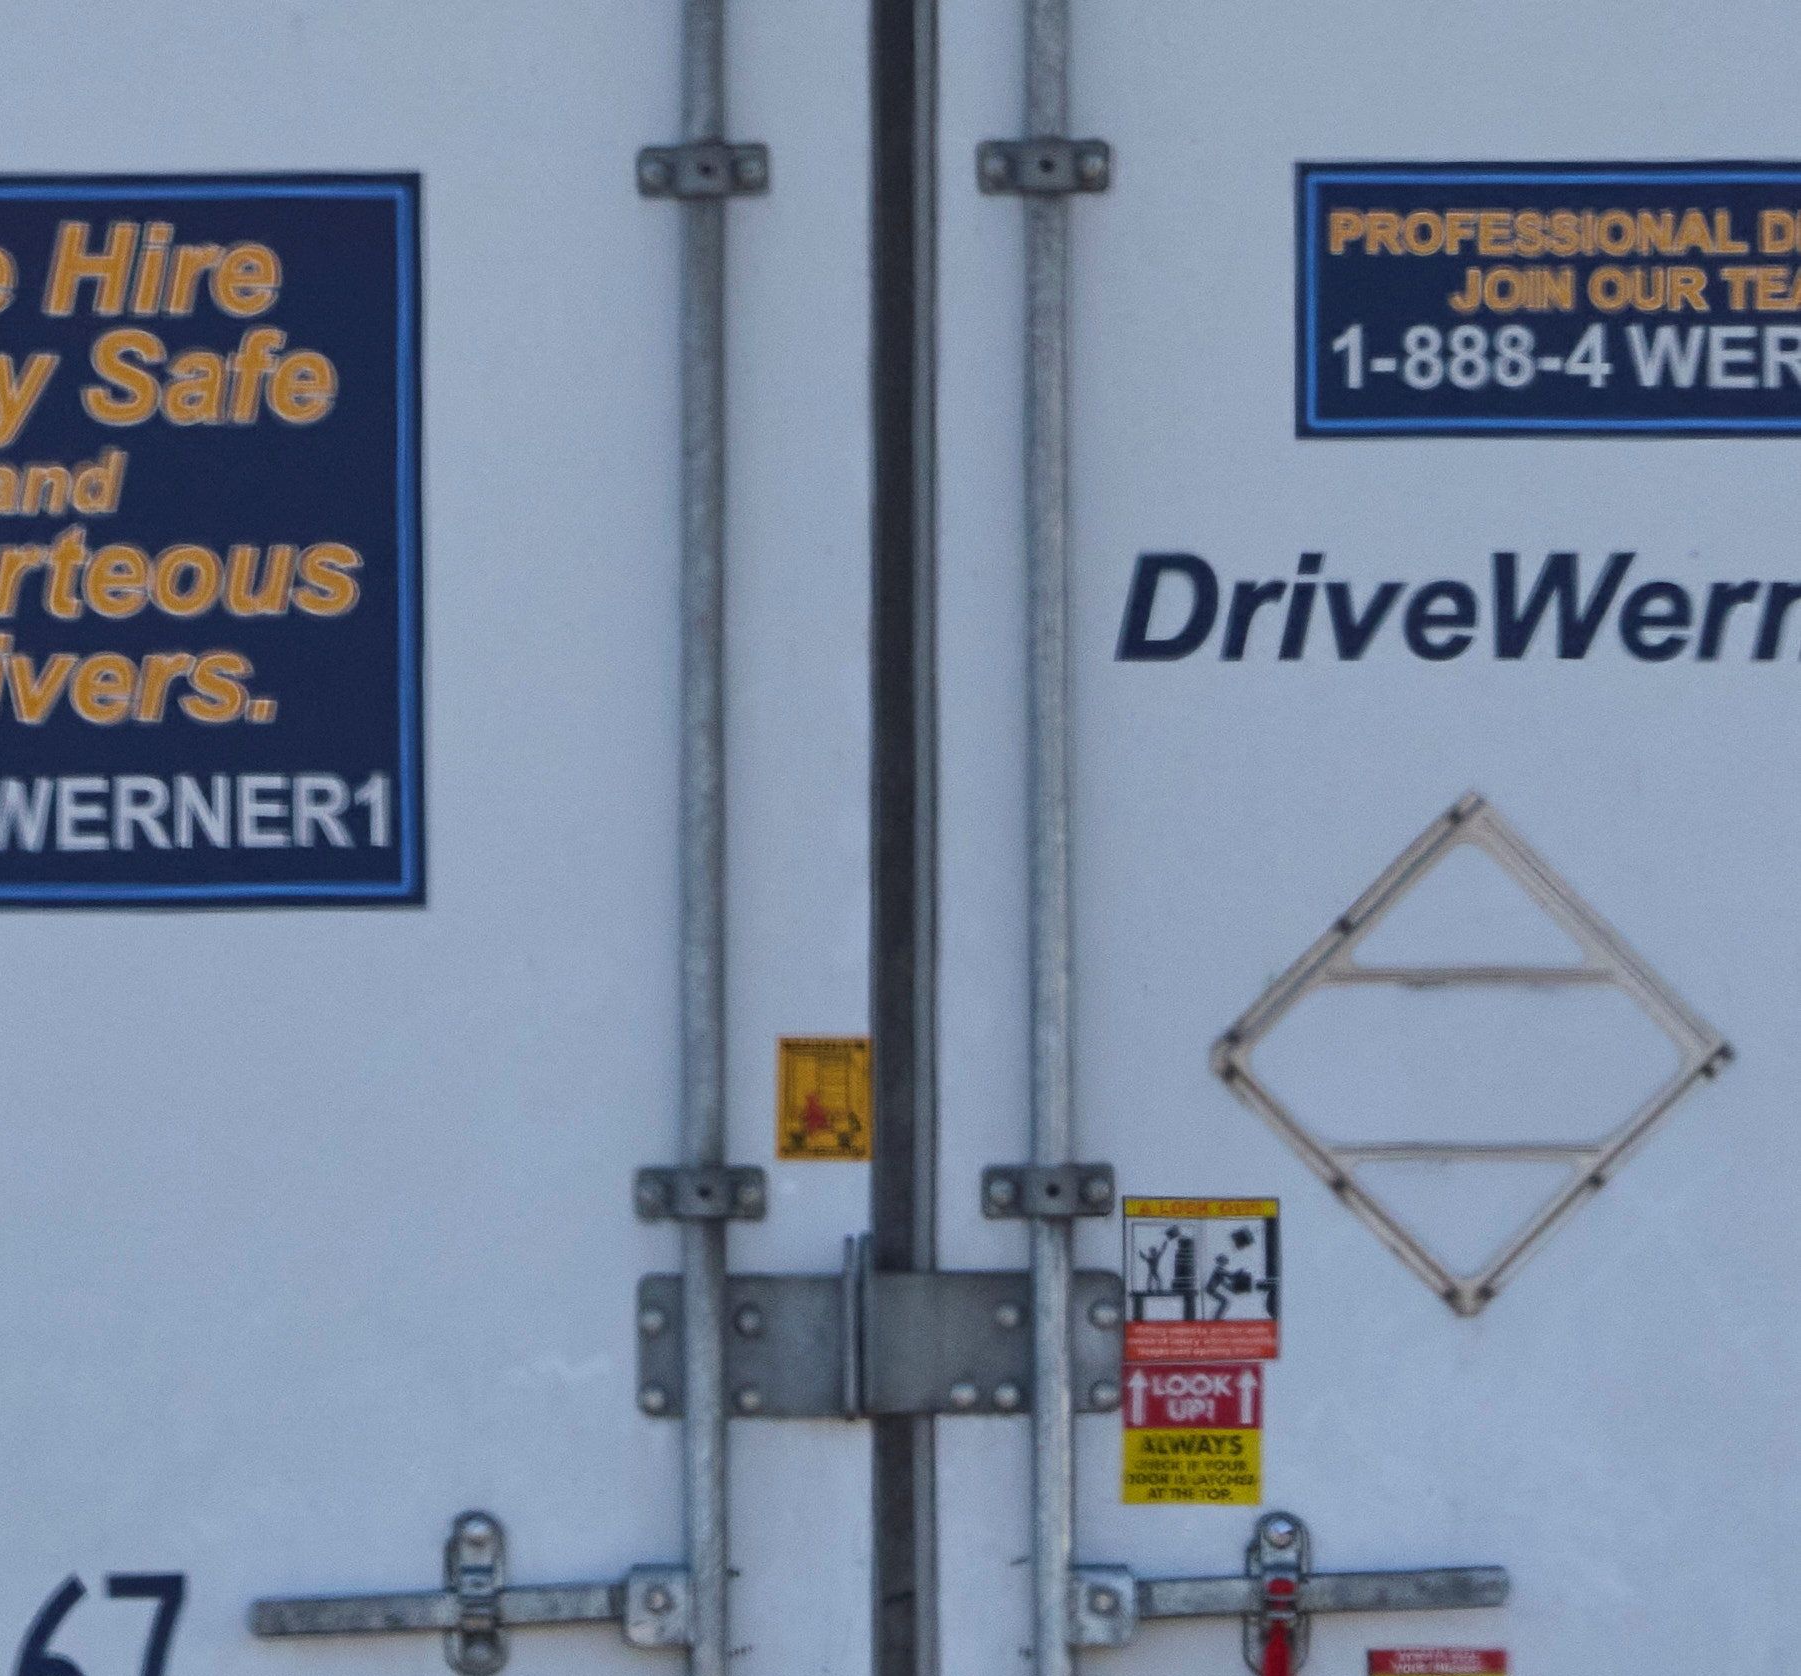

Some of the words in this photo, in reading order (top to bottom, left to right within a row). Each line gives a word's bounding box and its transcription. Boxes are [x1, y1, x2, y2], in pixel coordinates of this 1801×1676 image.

[1329, 208, 1749, 257] PROFESSIONAL
[1757, 209, 1801, 256] D
[42, 221, 282, 317] Hire
[1450, 266, 1573, 315] JOIN
[1588, 265, 1710, 314] OUR
[1718, 265, 1801, 312] TE
[83, 328, 339, 427] Safe
[1331, 324, 1611, 390] 1-888-4
[1151, 1373, 1233, 1397] LOOK
[1141, 1434, 1244, 1456] ALWAYS
